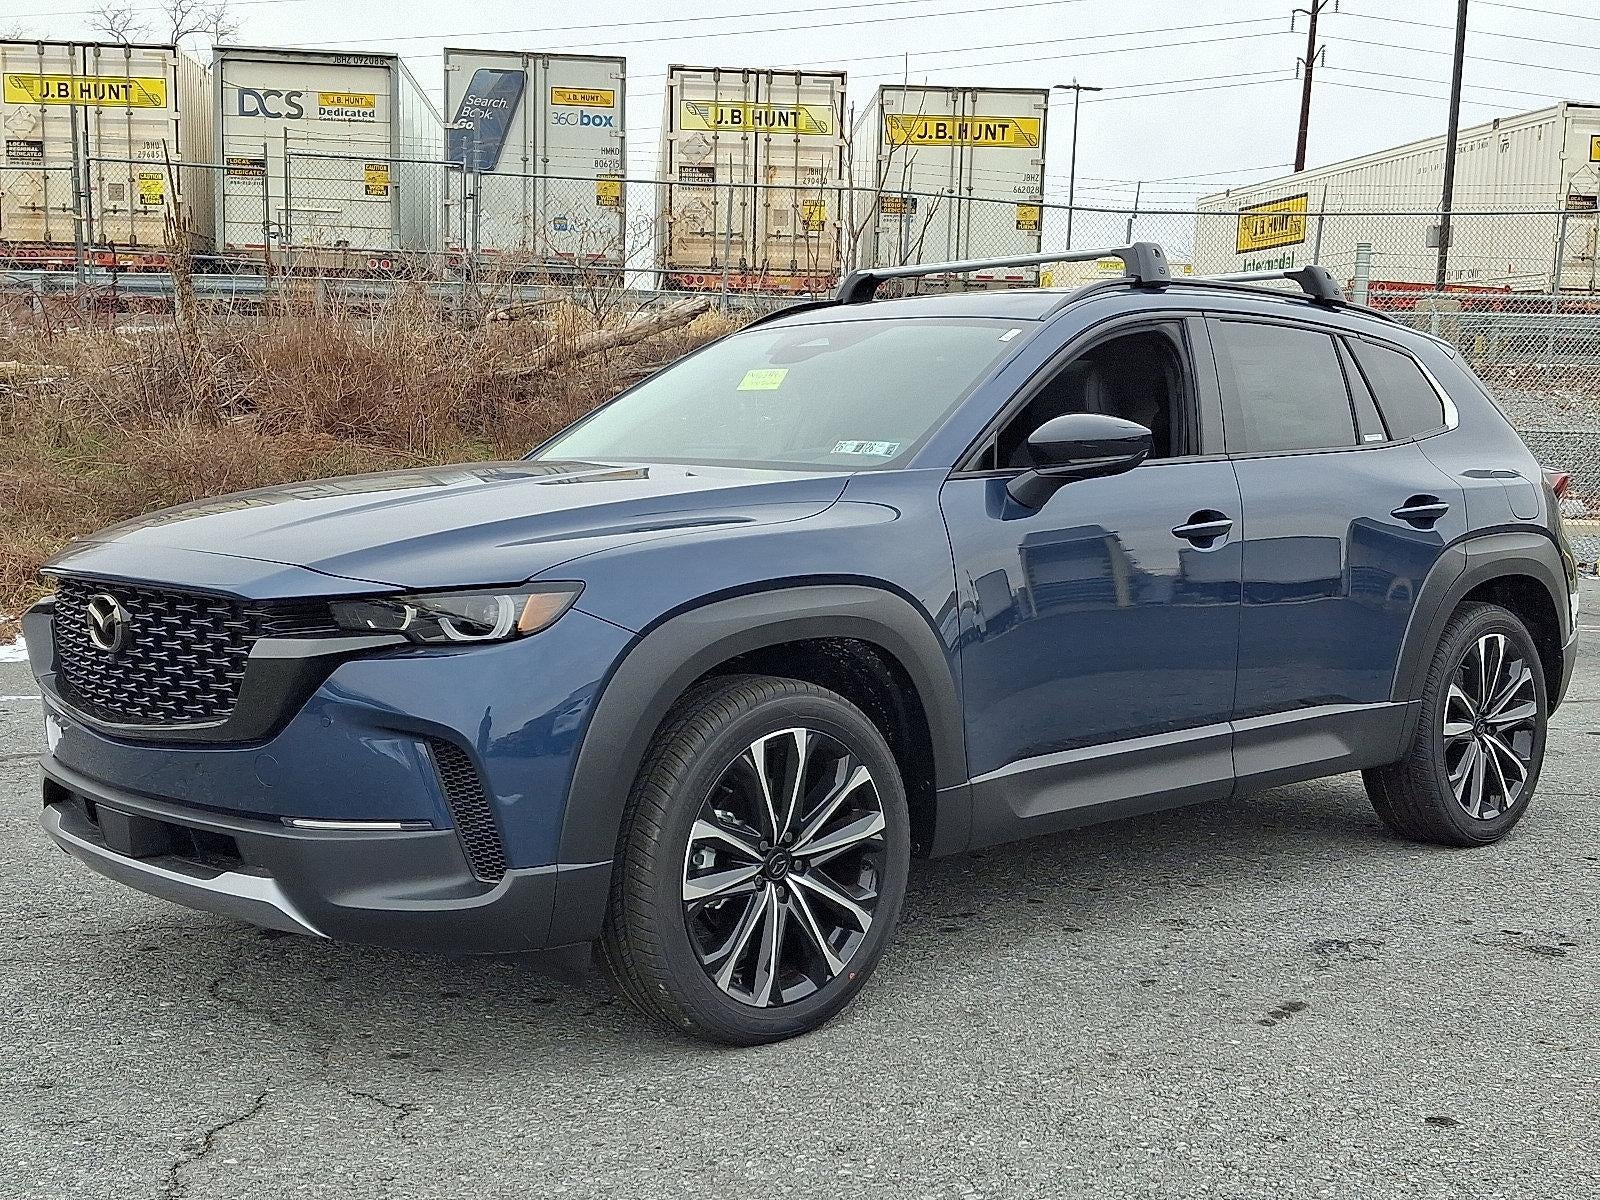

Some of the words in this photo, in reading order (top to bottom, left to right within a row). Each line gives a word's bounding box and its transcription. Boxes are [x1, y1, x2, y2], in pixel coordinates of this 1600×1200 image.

[80, 84, 133, 100] HUNT
[238, 88, 304, 119] DCS
[466, 94, 508, 109] Search.
[318, 107, 375, 118] Dedicated
[752, 110, 801, 127] HUNT
[916, 122, 952, 139] J.B.
[958, 122, 1010, 141] HUNT
[1013, 186, 1040, 194] 662028
